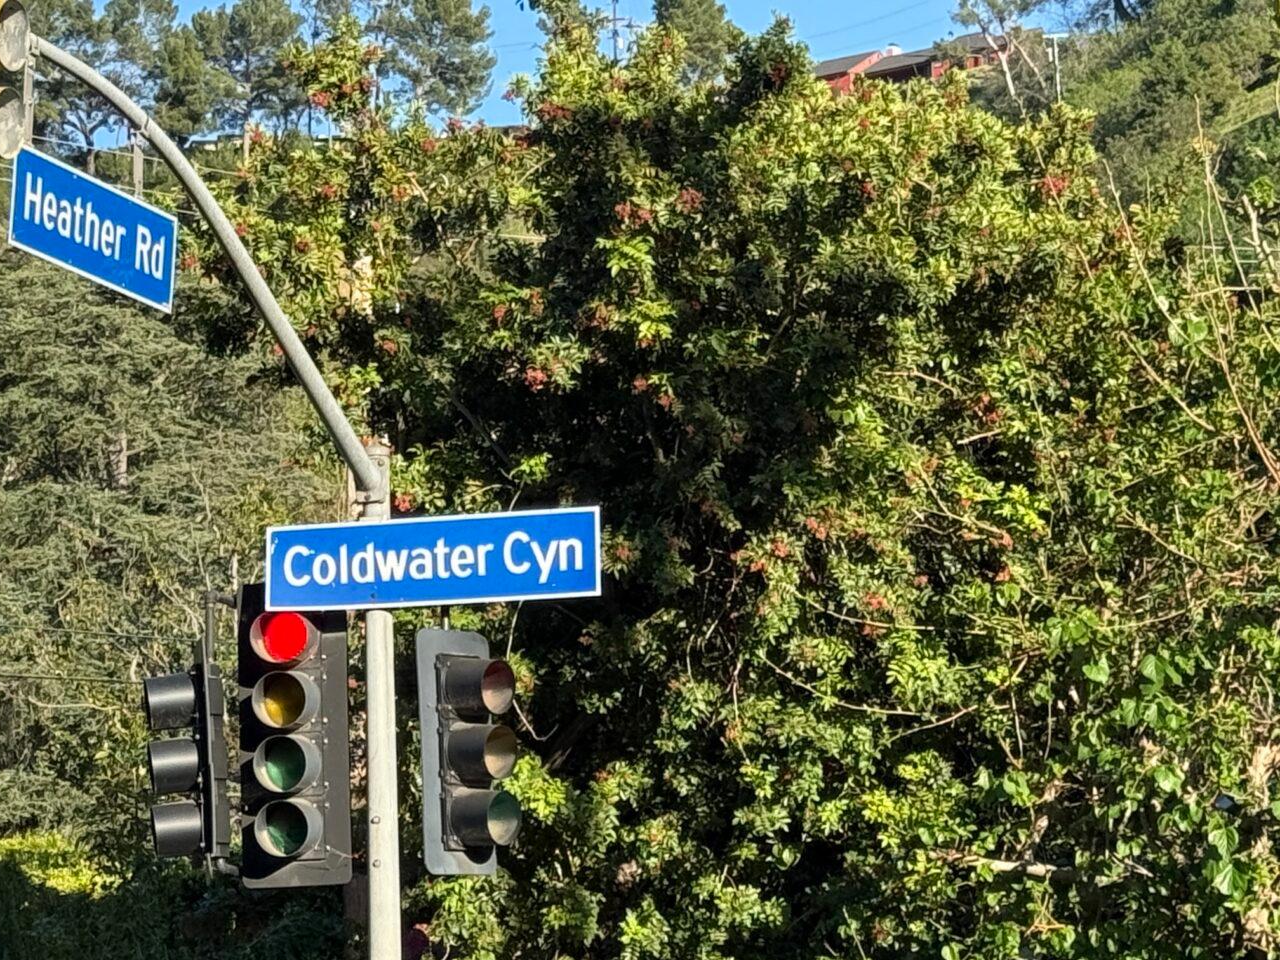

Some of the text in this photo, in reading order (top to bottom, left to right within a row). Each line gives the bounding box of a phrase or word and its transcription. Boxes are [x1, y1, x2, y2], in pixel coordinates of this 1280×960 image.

[24, 171, 166, 280] Heather Rd
[283, 531, 583, 587] Coldwater Cyn
